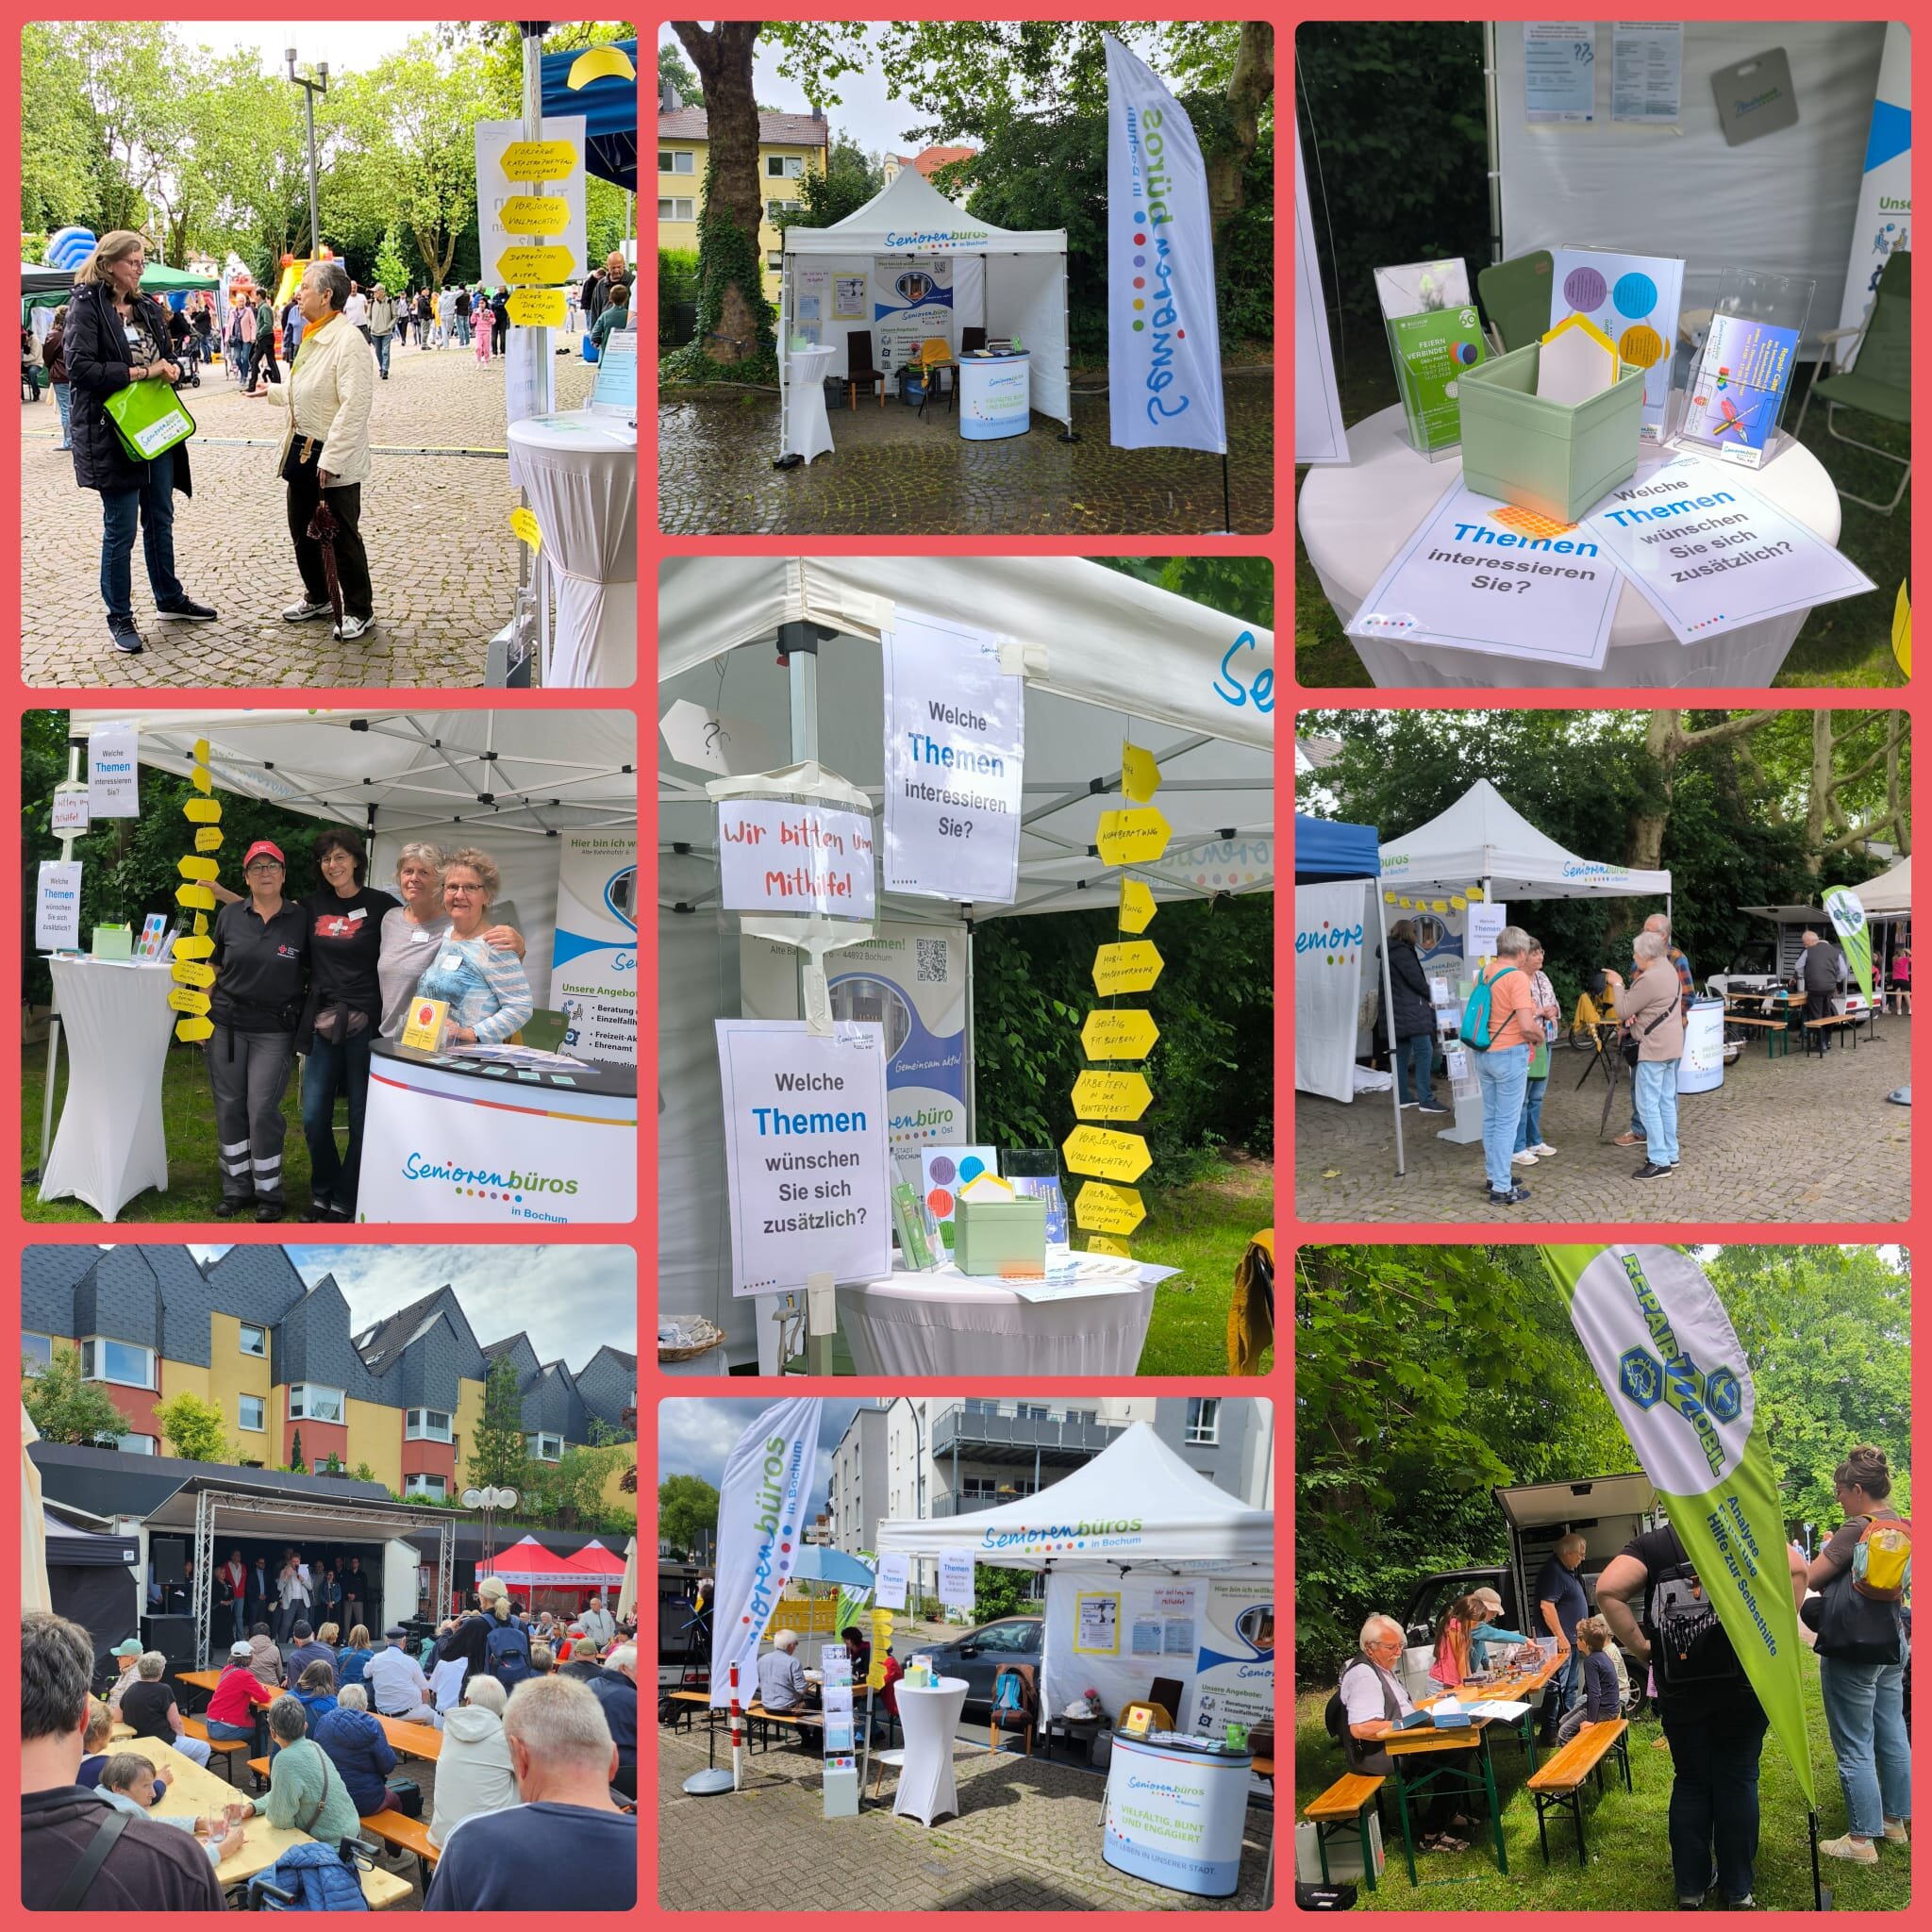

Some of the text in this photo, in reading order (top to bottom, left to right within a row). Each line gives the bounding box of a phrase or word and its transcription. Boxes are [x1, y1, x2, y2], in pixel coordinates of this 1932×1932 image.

[515, 201, 560, 211] VORSORGE
[508, 217, 561, 226] VOLLMACHTEN
[1407, 346, 1448, 360] VERBINDET
[1419, 338, 1446, 348] FEIERN
[1776, 347, 1789, 372] Repair
[1613, 479, 1690, 502] Welche
[1605, 491, 1737, 527] Themen
[1640, 513, 1749, 544] wünschen
[1455, 524, 1599, 558] Themen
[1669, 530, 1757, 558] Sie sich
[1427, 549, 1596, 581] interessieren
[1671, 541, 1793, 583] zusätzlich?
[1471, 575, 1532, 594] Sie?
[928, 700, 987, 732] Welche
[908, 732, 1005, 778] Themen
[96, 762, 130, 773] Themen
[94, 777, 132, 786] interessieren
[905, 778, 1008, 814] interessieren
[724, 821, 767, 845] Wir
[781, 818, 843, 856] bitten
[938, 817, 974, 839] Sie?
[571, 838, 625, 847] Hier bin ich
[44, 889, 75, 898] Themen
[765, 867, 852, 898] Mithilfe!
[771, 945, 786, 954] Alte
[842, 951, 864, 960] 44892
[865, 953, 892, 962] Bochum
[562, 983, 595, 994] Unsere
[597, 1005, 634, 1016] Beratung
[1094, 1019, 1125, 1029] GEISTIG
[594, 1041, 633, 1053] Ehrenamt
[896, 1053, 962, 1074] Gemeinsam aktiv!
[774, 1073, 844, 1091] Welche
[1080, 1078, 1129, 1091] ARBEITEN
[1080, 1105, 1130, 1113] RENTENZEIT
[752, 1108, 867, 1136] Themen
[1078, 1132, 1135, 1151] VORSORGE
[765, 1150, 860, 1172] wünschen
[1070, 1151, 1133, 1169] VOLLMACHTEN
[402, 1152, 578, 1195] Seniorenbüros
[778, 1179, 851, 1202] Sie sich
[511, 1207, 568, 1224] in Bochum
[763, 1208, 867, 1234] zusätzlich?
[1623, 1254, 1681, 1362] REPAIR
[787, 1441, 802, 1515] in Bochum
[981, 1518, 1142, 1548] Seniorenbüros
[1726, 1495, 1759, 1558] Analyse
[1102, 1537, 1141, 1547] Bochum
[943, 1564, 970, 1573] Themen
[1707, 1513, 1777, 1657] Hilfe zur Selbsthilfe
[1202, 1684, 1262, 1699] Unsere Angebote:
[1127, 1776, 1205, 1796] Seniorenbüros
[1122, 1806, 1205, 1833] VIELFÄLTIG, BUNT
[1122, 1817, 1201, 1843] UND ENGAGIERT
[1108, 1837, 1217, 1875] GUT LEBEN IN UNSERER STADT.
